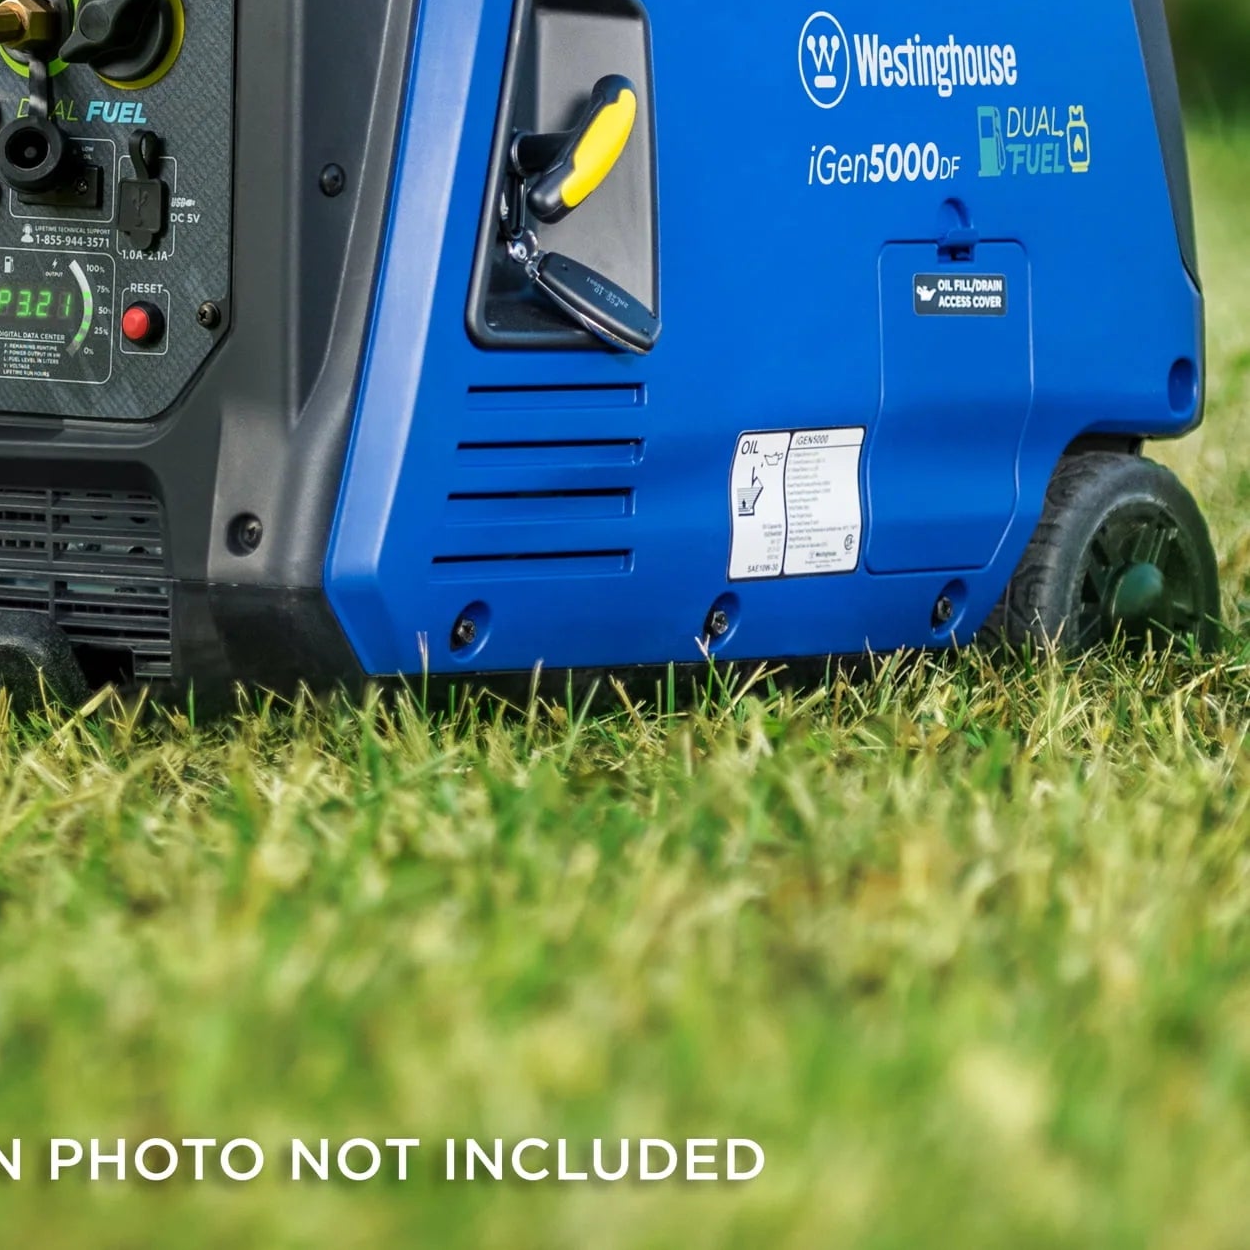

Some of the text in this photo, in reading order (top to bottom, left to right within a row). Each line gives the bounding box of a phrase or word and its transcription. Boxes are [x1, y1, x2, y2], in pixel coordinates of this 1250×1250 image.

[853, 33, 1018, 98] Westinghouse
[17, 97, 147, 124] DAL FUEL
[1006, 105, 1064, 138] DUAL
[1006, 142, 1065, 175] FUEL
[170, 213, 201, 224] DC 5V
[35, 234, 109, 248] 1-855-944-3571
[121, 249, 168, 261] 1.0A-2.1A
[86, 263, 106, 274] 100%
[129, 282, 164, 294] RESET
[937, 278, 1003, 293] OIL FILL/DRAIN
[938, 295, 1002, 308] ACCESS COVER
[22, 331, 39, 339] DATA
[40, 333, 65, 341] CENTER
[741, 439, 759, 455] OIL
